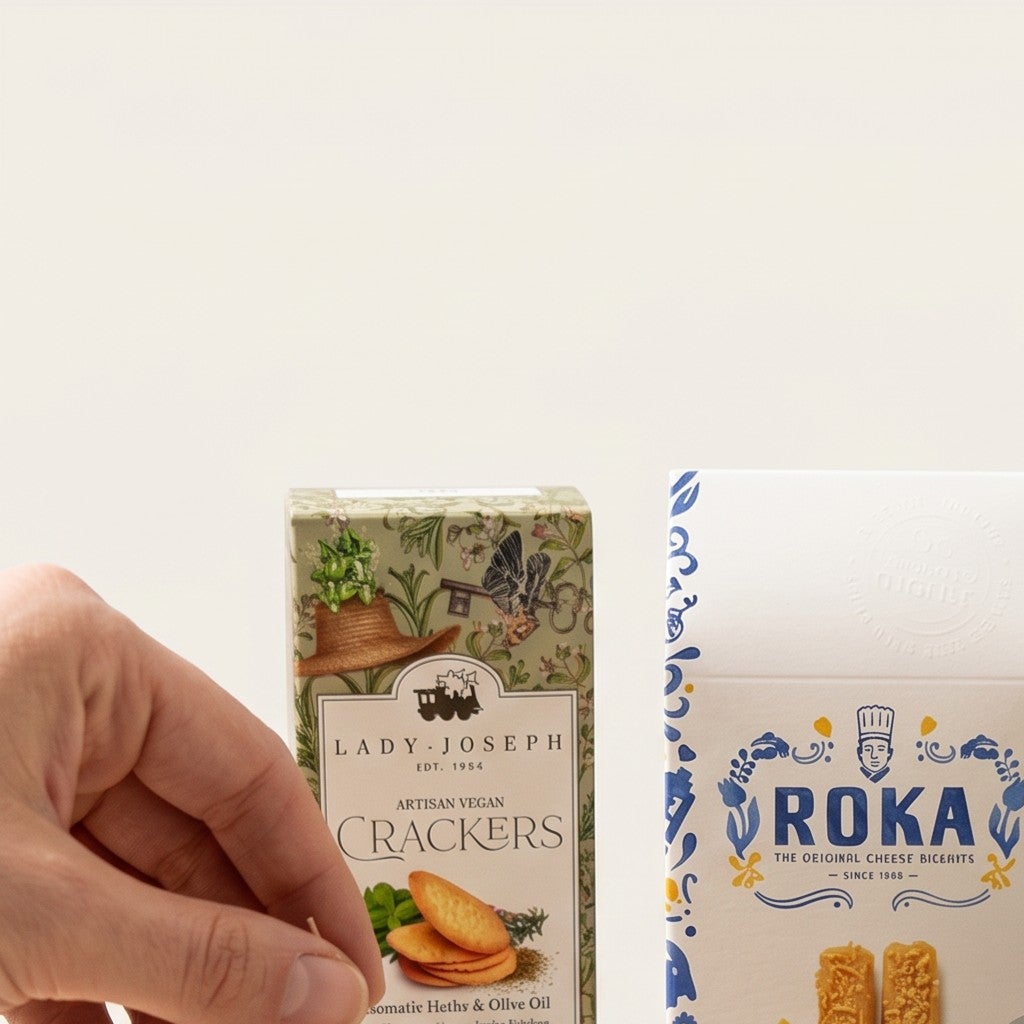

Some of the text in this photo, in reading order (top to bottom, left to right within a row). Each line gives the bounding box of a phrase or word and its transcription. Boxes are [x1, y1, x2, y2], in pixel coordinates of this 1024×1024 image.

[396, 797, 505, 810] ARTISAN VEGAN
[775, 786, 975, 846] ROKA
[337, 815, 563, 862] CRACKERS
[774, 852, 797, 863] THE
[866, 853, 914, 864] CHEESE
[843, 871, 874, 880] SINCE
[473, 998, 485, 1012] &
[529, 996, 551, 1010] Oil
